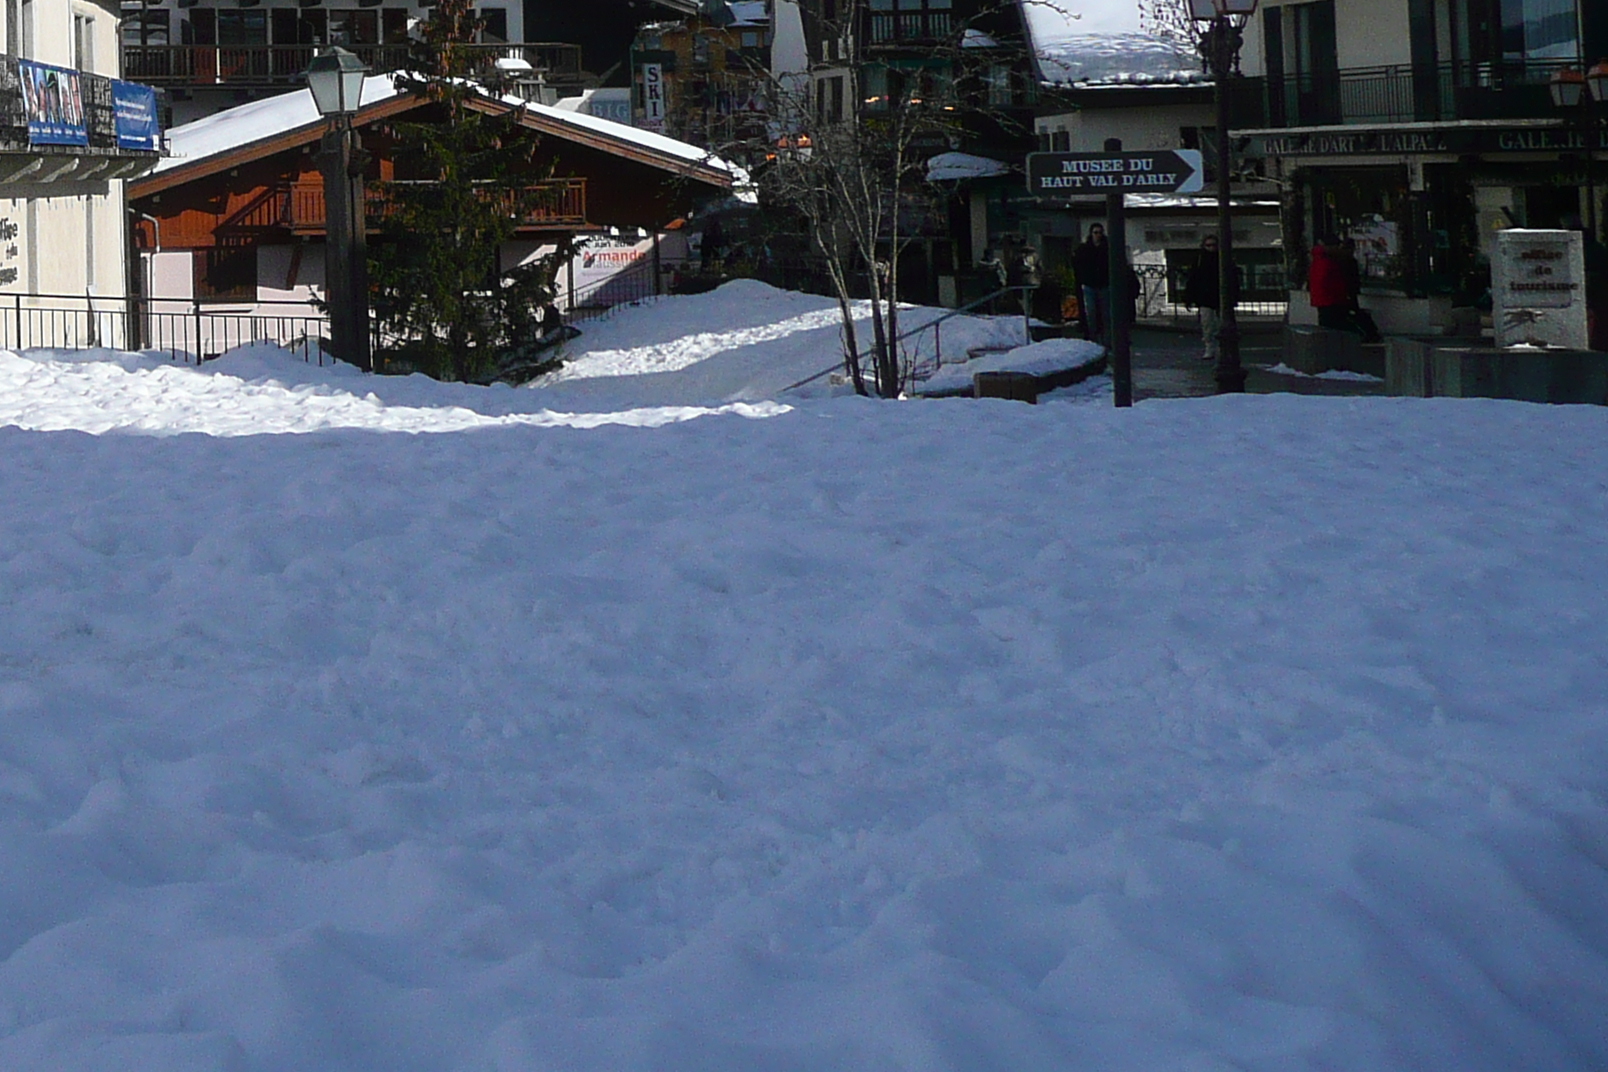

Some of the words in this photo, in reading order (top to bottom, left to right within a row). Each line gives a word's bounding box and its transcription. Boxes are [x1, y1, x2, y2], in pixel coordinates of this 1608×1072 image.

[647, 66, 661, 117] SKI
[592, 103, 629, 118] BIG
[1061, 159, 1124, 173] MUSEE
[1129, 158, 1154, 171] DU
[1040, 176, 1084, 188] HAUT
[1088, 175, 1118, 187] VAL
[1121, 173, 1177, 186] D'ARLY
[1534, 264, 1553, 276] de
[1509, 280, 1579, 292] tourisme
